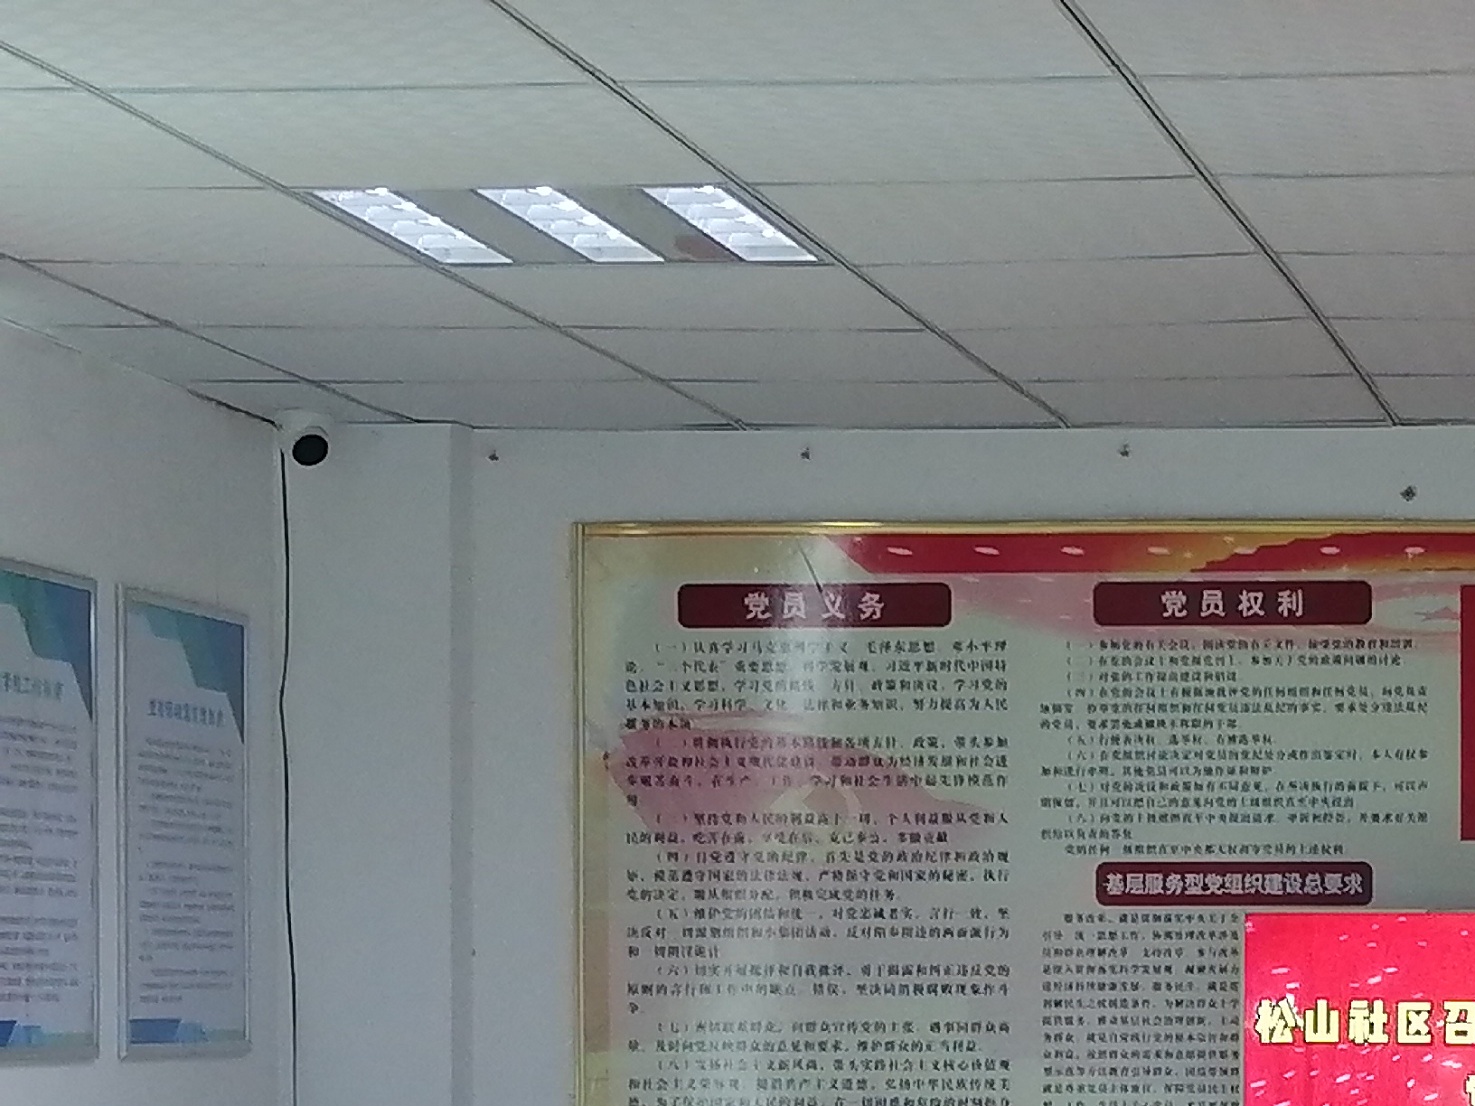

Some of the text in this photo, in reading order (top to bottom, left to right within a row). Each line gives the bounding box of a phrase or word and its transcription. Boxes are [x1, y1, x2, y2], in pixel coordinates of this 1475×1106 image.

[743, 591, 886, 621] 党员义务
[1160, 589, 1304, 618] 党员权利
[1105, 871, 1364, 896] 基层服务型党组织建设总要求
